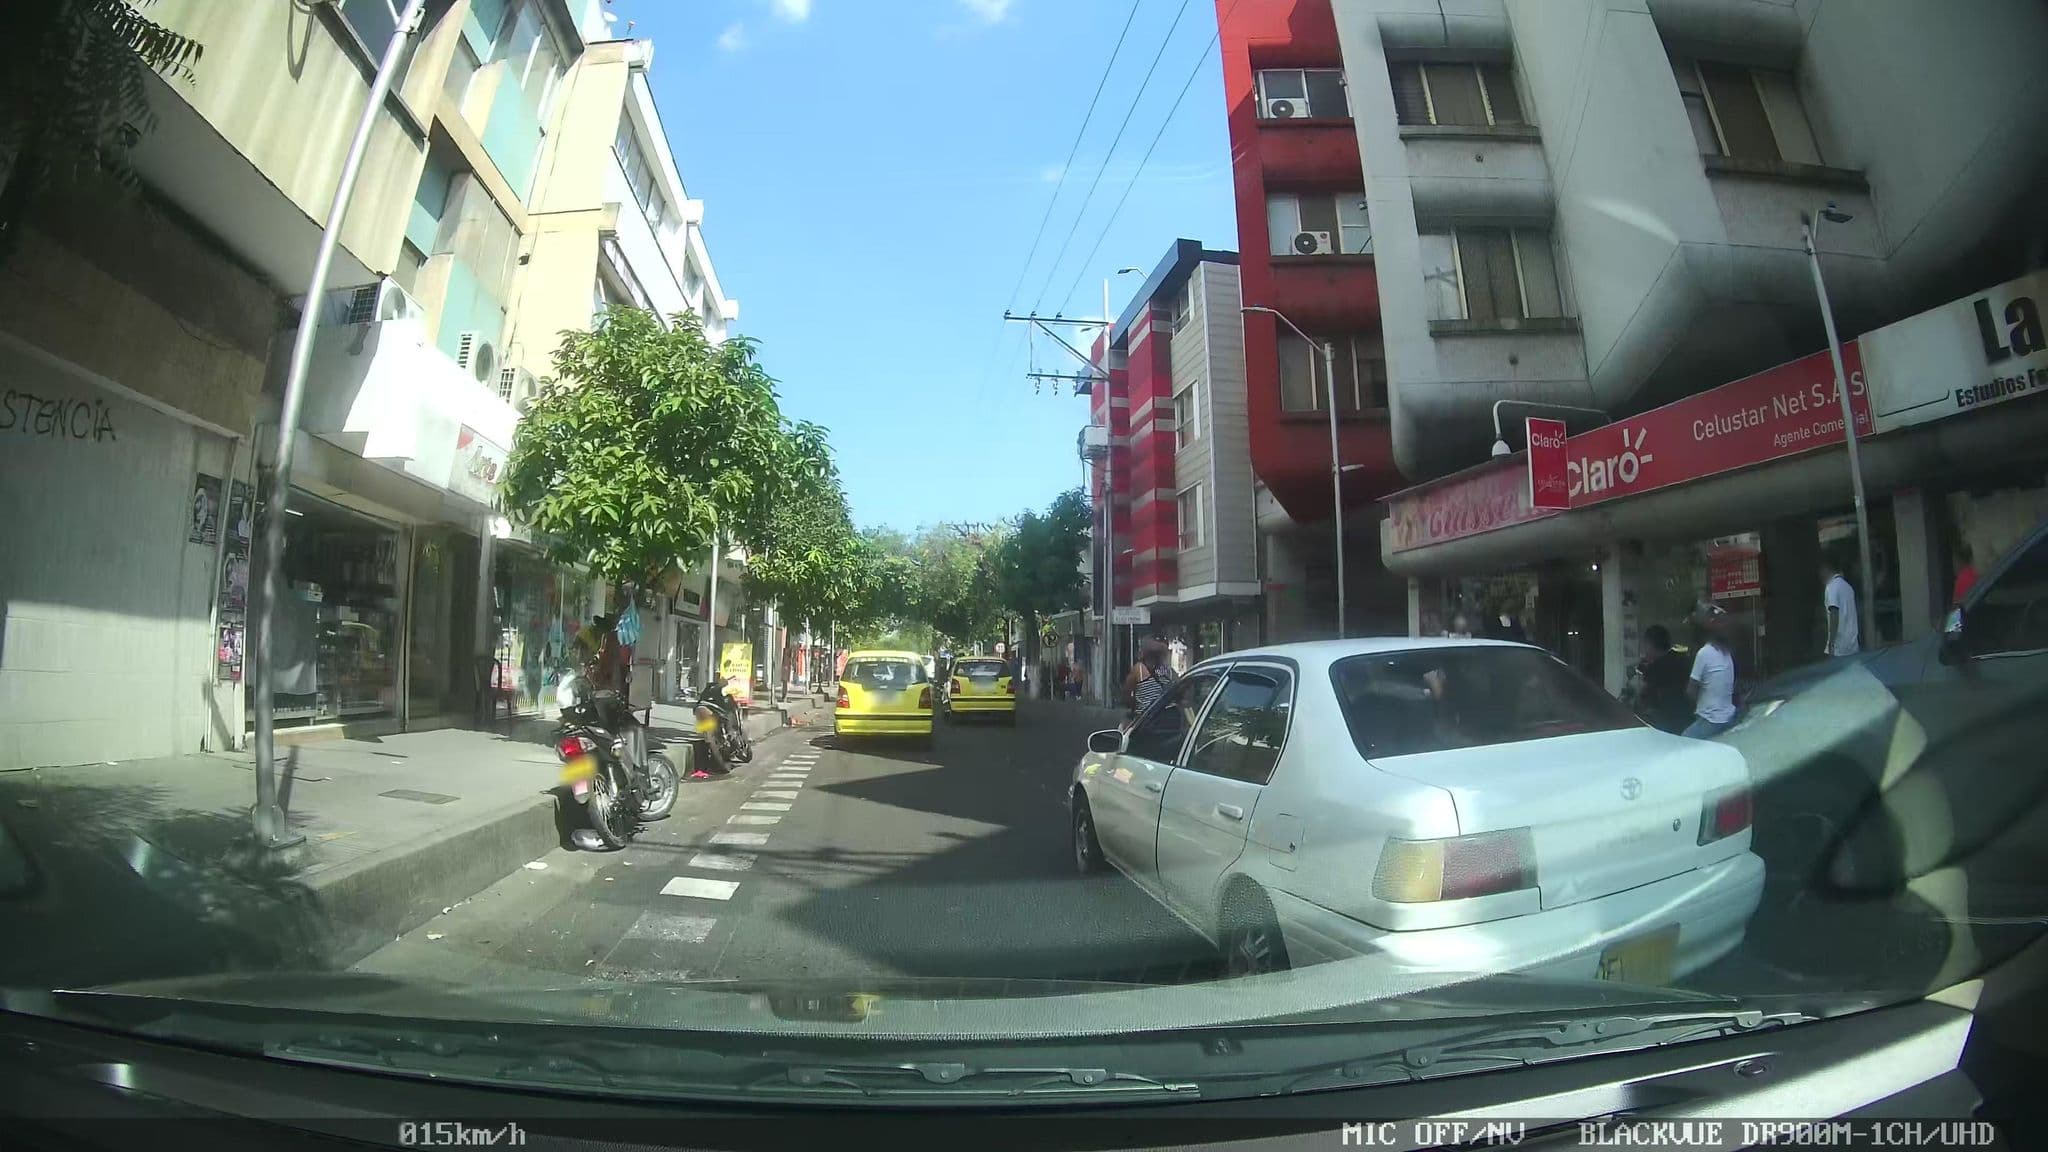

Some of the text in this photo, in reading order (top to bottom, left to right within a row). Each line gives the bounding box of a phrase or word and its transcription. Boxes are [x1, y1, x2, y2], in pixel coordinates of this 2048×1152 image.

[1973, 296, 2047, 366] La
[1955, 374, 2027, 408] Estudios
[1693, 405, 1768, 441] Celustar
[1772, 390, 1808, 419] Net
[1774, 410, 1870, 448] Agente Comeial
[1531, 431, 1564, 449] Claro
[1567, 431, 1650, 498] Claro
